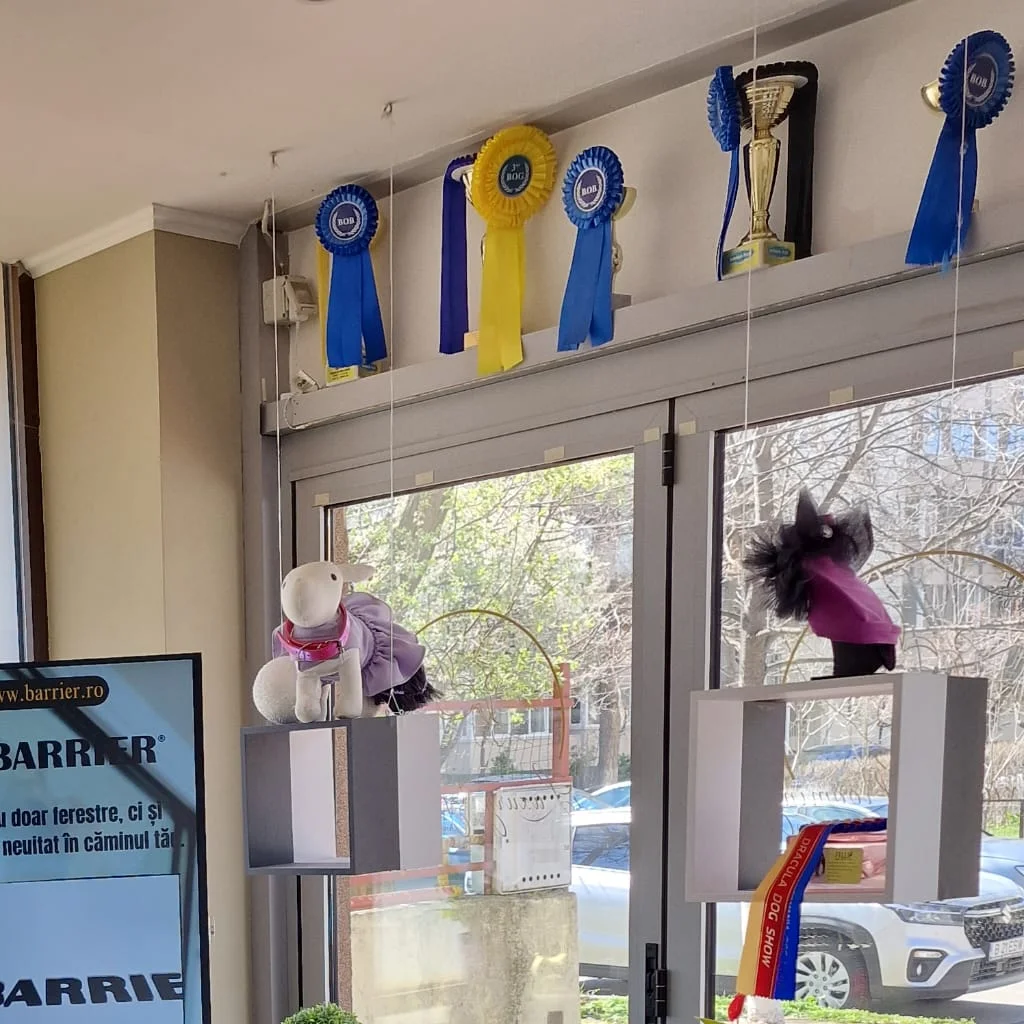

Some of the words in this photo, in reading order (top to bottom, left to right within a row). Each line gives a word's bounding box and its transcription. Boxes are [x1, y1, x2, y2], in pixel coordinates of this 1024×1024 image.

[581, 184, 597, 196] BOB
[337, 217, 355, 226] BOB
[11, 808, 48, 827] doar
[53, 804, 123, 825] ferestre,
[128, 801, 143, 821] ci
[2, 835, 60, 856] neuitat
[62, 832, 79, 853] în
[84, 831, 149, 852] căminul
[778, 837, 811, 887] DRACULA
[768, 893, 782, 922] DOG
[762, 926, 776, 968] SHOW
